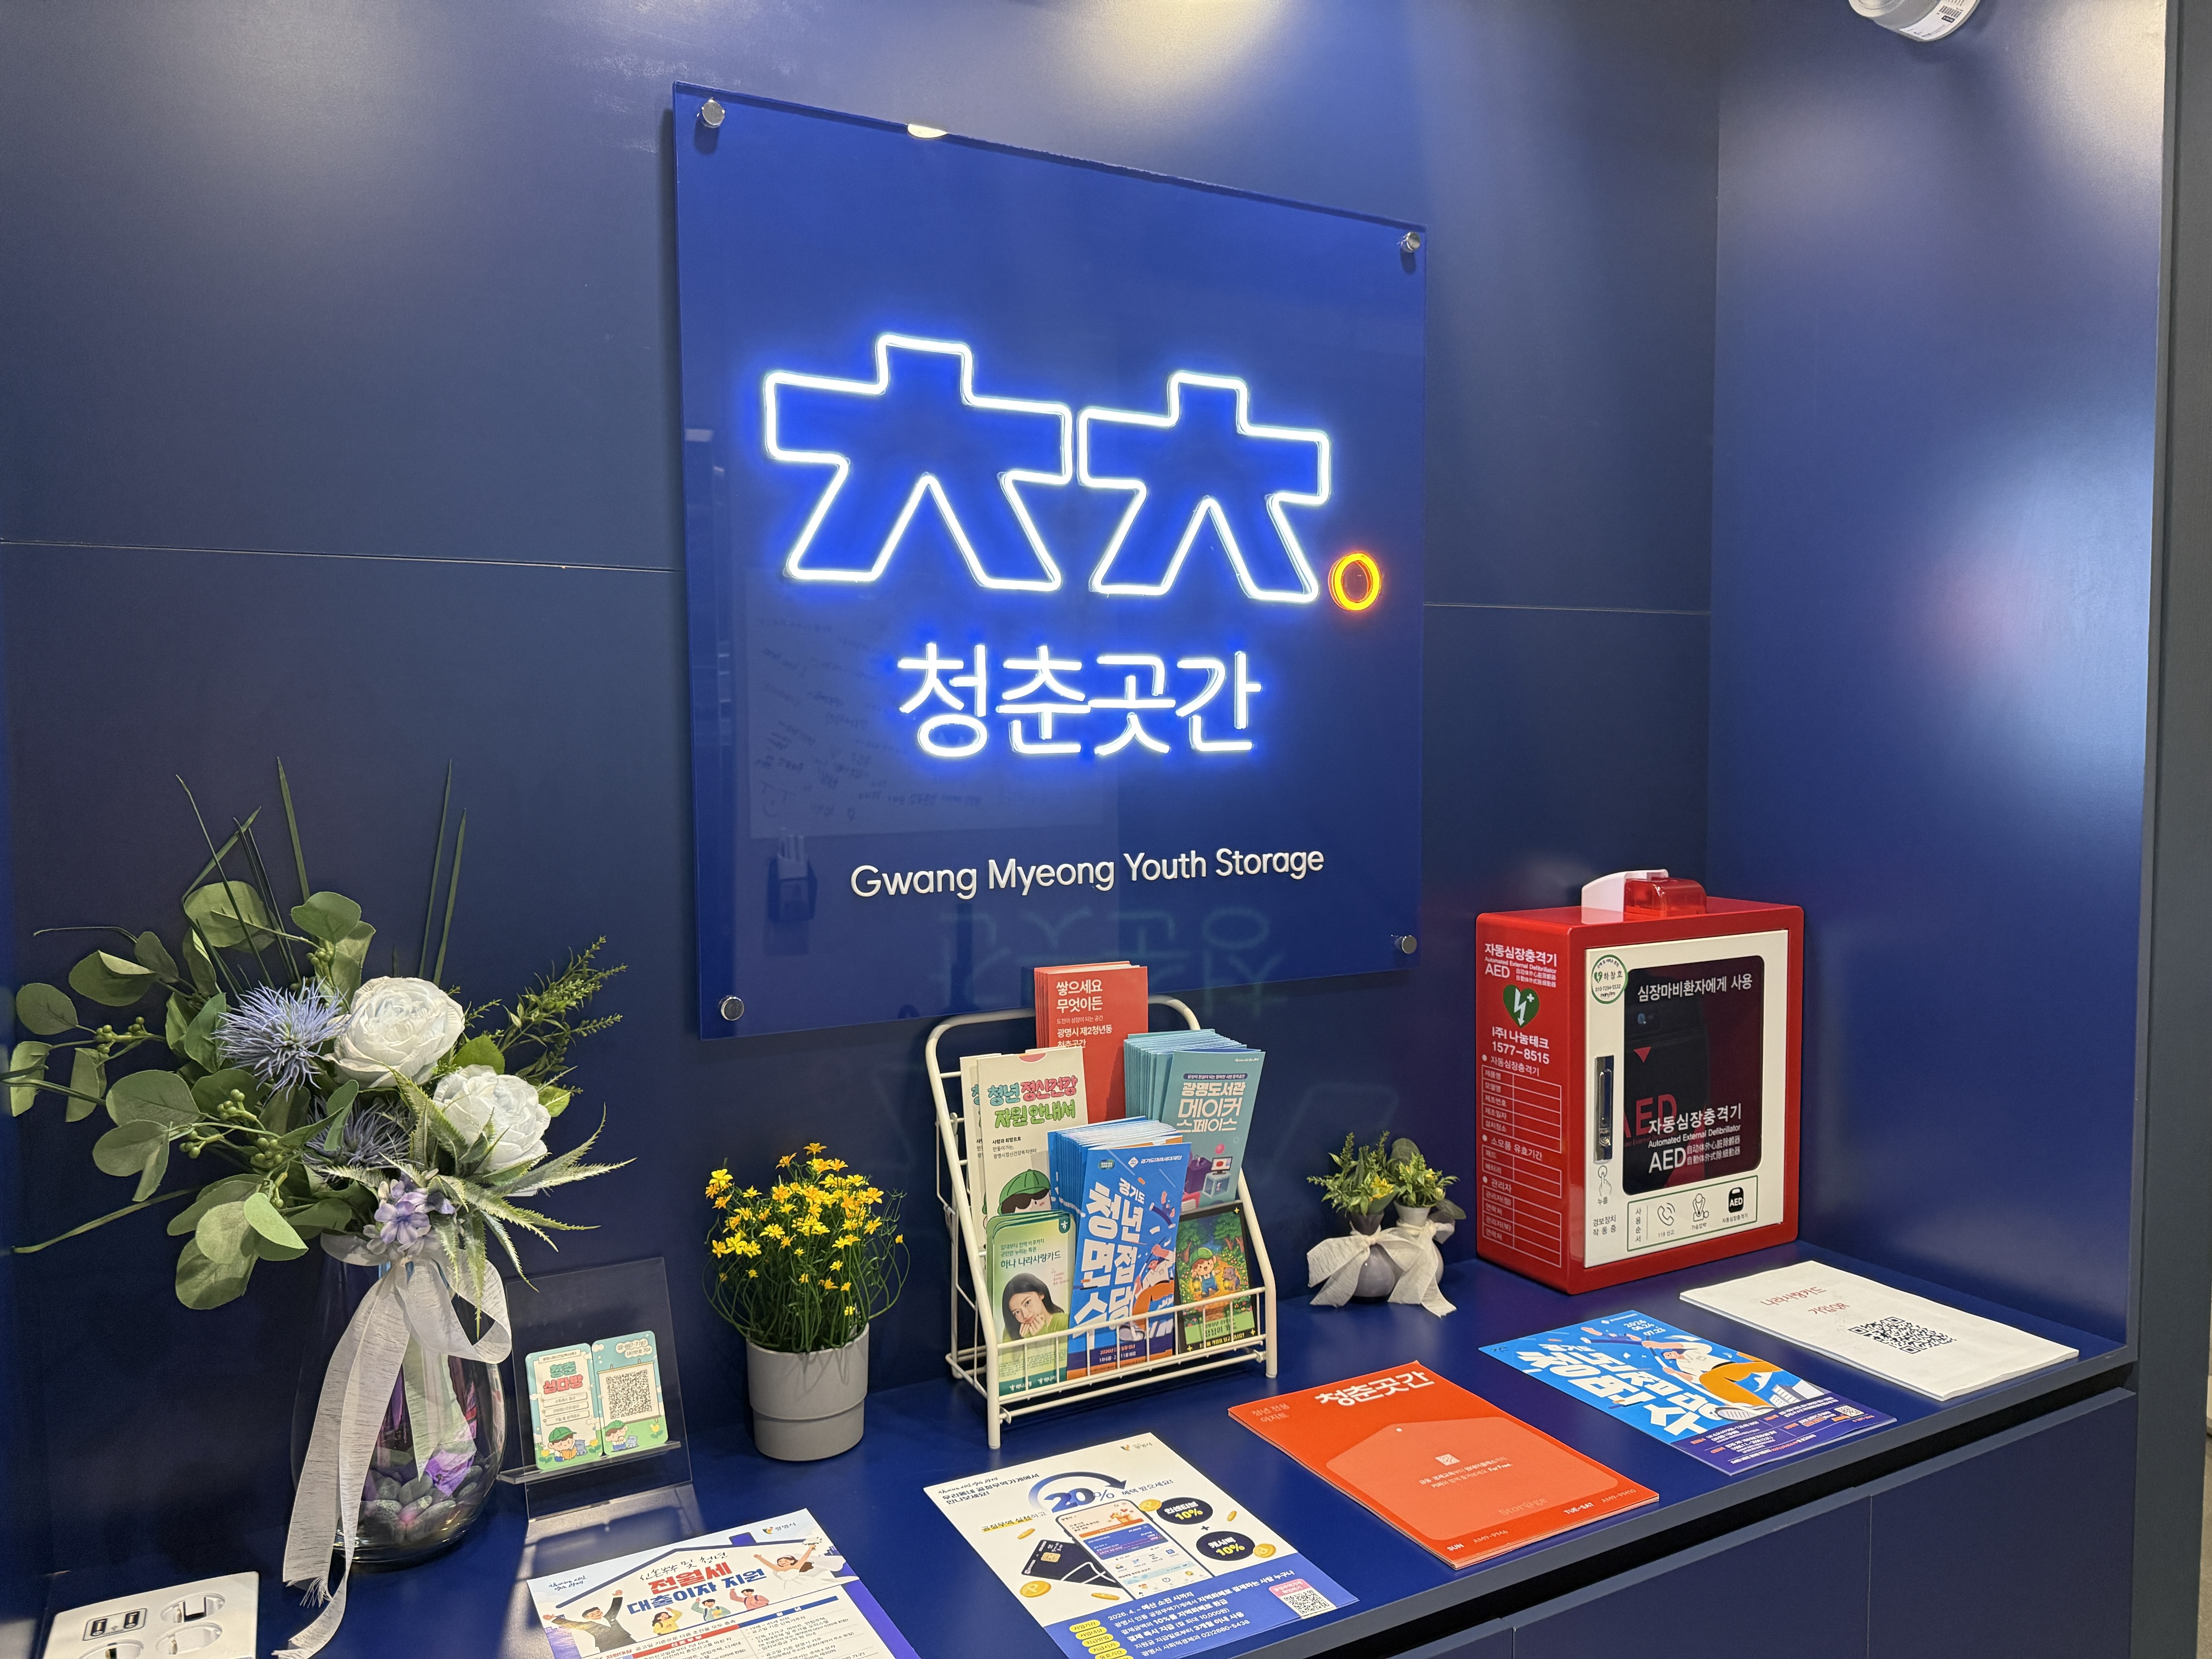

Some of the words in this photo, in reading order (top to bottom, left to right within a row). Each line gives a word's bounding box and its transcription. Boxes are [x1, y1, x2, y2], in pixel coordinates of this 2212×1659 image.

[897, 642, 1263, 758] 청춘곳간
[850, 864, 977, 900] Gwang
[988, 858, 1114, 896] Myeong
[1123, 850, 1206, 881] Youth
[1215, 847, 1324, 880] Storage
[1485, 943, 1557, 966] 자동심장충격기
[1485, 963, 1510, 978] AED
[1056, 979, 1103, 996] 쌓으세요
[1637, 976, 1727, 1002] 심장마비환자에게
[1731, 973, 1753, 990] 사용
[1056, 996, 1103, 1013] 무엇이든
[1057, 1027, 1079, 1038] 광명시
[1080, 1024, 1112, 1035] 제2청년동
[1493, 1041, 1550, 1065] 1577-8515
[1490, 1056, 1539, 1077] 자동심장충격기
[987, 1082, 1021, 1106] 청년
[1020, 1075, 1078, 1102] 정신건강
[1182, 1081, 1246, 1096] 광명도서관
[994, 1105, 1028, 1128] 자원
[1028, 1099, 1076, 1125] 안내서
[1178, 1097, 1243, 1118] 메이커
[1648, 1102, 1741, 1135] 자동심장충격기
[1176, 1118, 1237, 1133] 스페이스
[1648, 1135, 1681, 1148] Automated
[1683, 1131, 1707, 1141] External
[1709, 1125, 1741, 1136] Defibrillator
[1491, 1137, 1511, 1150] 소모품
[1514, 1144, 1542, 1161] 유효기간
[1648, 1147, 1686, 1173] AED
[1118, 1177, 1145, 1204] 경기도
[1491, 1178, 1511, 1193] 관리자
[1086, 1181, 1144, 1243] 청년
[1597, 1196, 1608, 1205] 누름
[1729, 1197, 1743, 1207] AED
[1593, 1215, 1616, 1227] 경보장치
[1001, 1258, 1016, 1269] 하나
[1018, 1250, 1061, 1266] 나라사랑카드
[1081, 1239, 1138, 1288] 면접
[1760, 1286, 1827, 1306] 나라사랑카드
[1072, 1285, 1133, 1350] 수당
[1808, 1302, 1850, 1314] 가입QR
[1623, 1319, 1647, 1328] 2026
[1539, 1343, 1596, 1352] 경기도
[1516, 1351, 1637, 1377] 청년
[1314, 1371, 1436, 1406] 청춘곳간
[1567, 1371, 1684, 1406] 면접
[1251, 1408, 1272, 1417] 청년
[1270, 1403, 1290, 1413] 전용
[1260, 1412, 1289, 1422] 아지트
[1642, 1392, 1721, 1436] 수당
[942, 1489, 975, 1500] 우리동네
[976, 1474, 1039, 1491] 공정무역가게에서
[1138, 1479, 1174, 1490] 받으세요!
[946, 1491, 990, 1504] 만나보세요!
[1044, 1488, 1115, 1513] 20%
[1163, 1501, 1199, 1513] 인센티브
[1497, 1496, 1550, 1516] Stor@ge
[981, 1520, 1014, 1531] 공정무역
[1014, 1512, 1047, 1523] 실천하고
[1173, 1508, 1205, 1520] 10%
[1207, 1537, 1237, 1548] 캐시백
[1214, 1544, 1246, 1556] 10%
[1445, 1543, 1465, 1551] SUN
[1471, 1529, 1509, 1544] AM9-PM6
[639, 1564, 679, 1580] 신혼부부
[681, 1559, 696, 1569] 및
[698, 1551, 729, 1565] 청년
[649, 1562, 731, 1593] 전월세
[627, 1582, 717, 1613] 대출이자
[721, 1568, 766, 1588] 지원
[1073, 1622, 1096, 1630] 사업기간
[1171, 1591, 1195, 1601] 시까지
[1079, 1628, 1103, 1637] 사업대상
[1113, 1618, 1135, 1627] 광명시
[1147, 1600, 1198, 1616] 공정무역가게에서
[1197, 1589, 1233, 1602] 지역화폐로
[1231, 1581, 1261, 1591] 결제하는
[1272, 1570, 1296, 1579] 누구나
[1086, 1636, 1109, 1644] 지급방법
[1119, 1622, 1154, 1634] 결제금액의
[1152, 1614, 1178, 1624] 10%를
[1175, 1603, 1214, 1617] 지역화폐로
[1092, 1643, 1116, 1652] 지급시기
[1198, 1608, 1231, 1619] 10,000원)
[1133, 1639, 1155, 1648] 지원금
[1154, 1628, 1194, 1642] 지급일로부터
[1192, 1621, 1215, 1630] 3개월
[606, 1649, 632, 1659] 지원대상
[655, 1636, 678, 1645] 기준으로
[1140, 1647, 1163, 1656] 광명시
[1161, 1635, 1202, 1649] 사회적경제과
